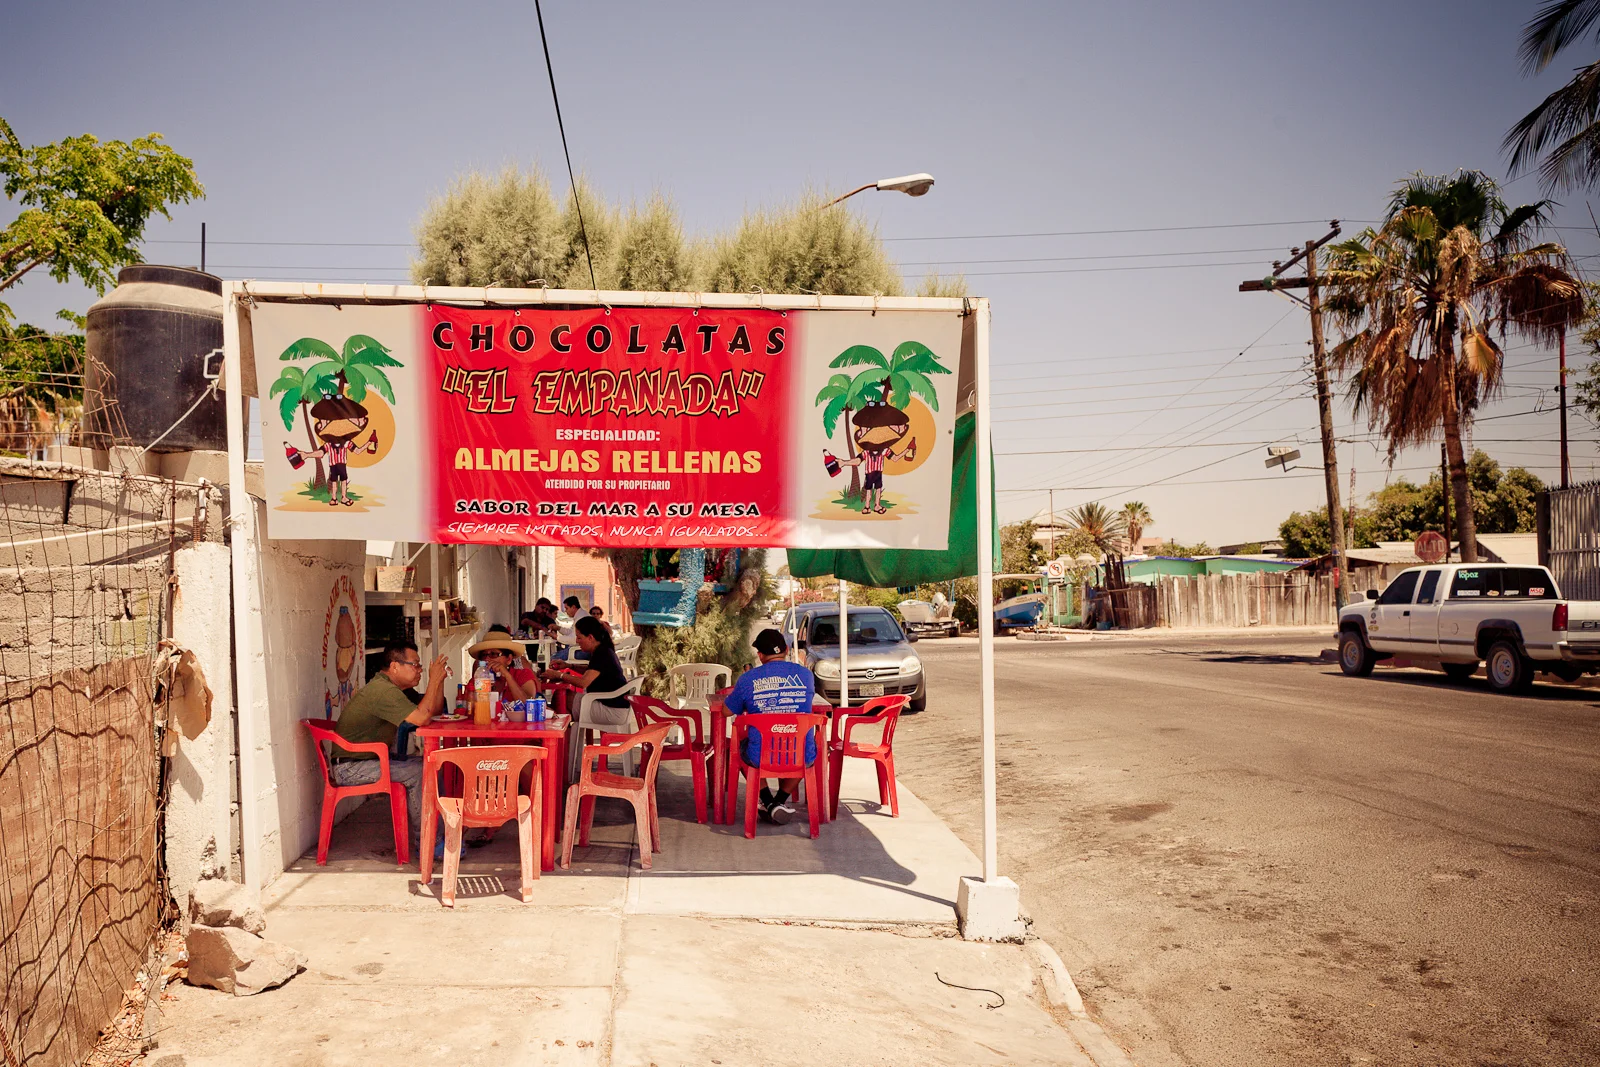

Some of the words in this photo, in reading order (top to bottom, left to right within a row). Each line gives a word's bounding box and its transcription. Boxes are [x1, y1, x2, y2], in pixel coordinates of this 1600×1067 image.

[432, 322, 786, 355] CHOCOLATAS
[531, 367, 765, 419] EMPANADA"
[555, 429, 661, 441] ESPECIALIDAD:
[454, 447, 600, 473] ALMEJAS
[612, 450, 762, 474] RELLENAS
[545, 479, 584, 490] ATENDIDO
[586, 480, 603, 490] POR
[605, 480, 617, 490] SU
[618, 480, 671, 491] PROPIETARIO
[455, 499, 531, 515] SABOR
[537, 501, 582, 517] DEL
[588, 502, 638, 517] MAR
[644, 502, 661, 517] A
[666, 502, 694, 517] SU
[699, 502, 762, 518] MESA
[447, 521, 520, 534] SIEMPRE
[525, 523, 604, 538] IMITADOS,
[609, 525, 665, 537] NUNCA
[669, 525, 769, 537] IGUALADOS...
[1417, 540, 1445, 553] ALTO
[771, 724, 799, 733] Coca-Cola
[476, 759, 510, 771] Coca-Cola
